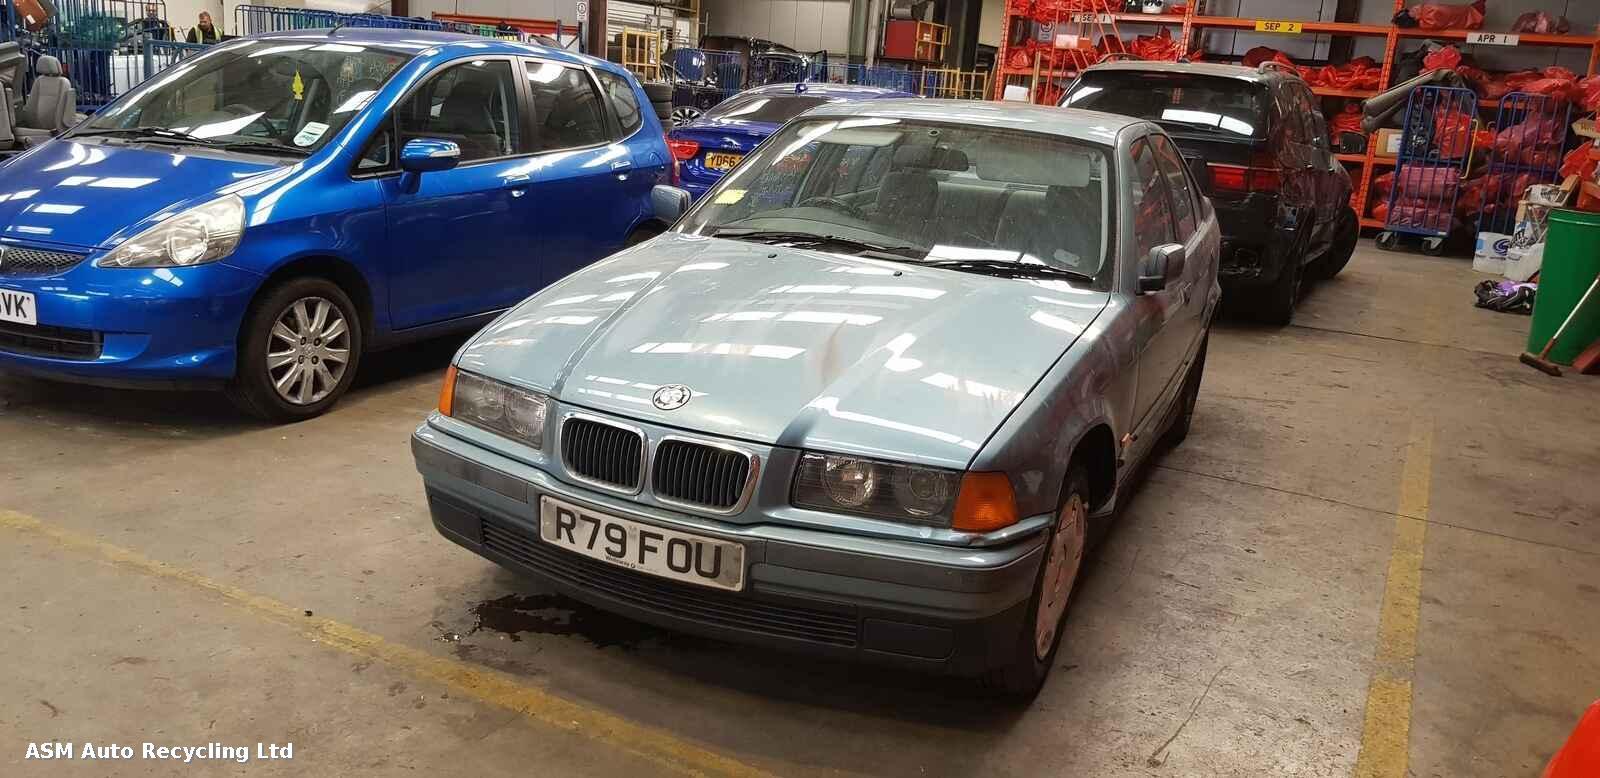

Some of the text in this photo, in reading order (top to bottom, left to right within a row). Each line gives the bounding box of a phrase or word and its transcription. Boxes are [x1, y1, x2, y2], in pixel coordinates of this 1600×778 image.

[1264, 22, 1295, 31] SEP 2
[1477, 34, 1496, 43] APR
[710, 155, 736, 167] YD66
[0, 292, 27, 318] VK
[556, 506, 722, 579] R79 FOU
